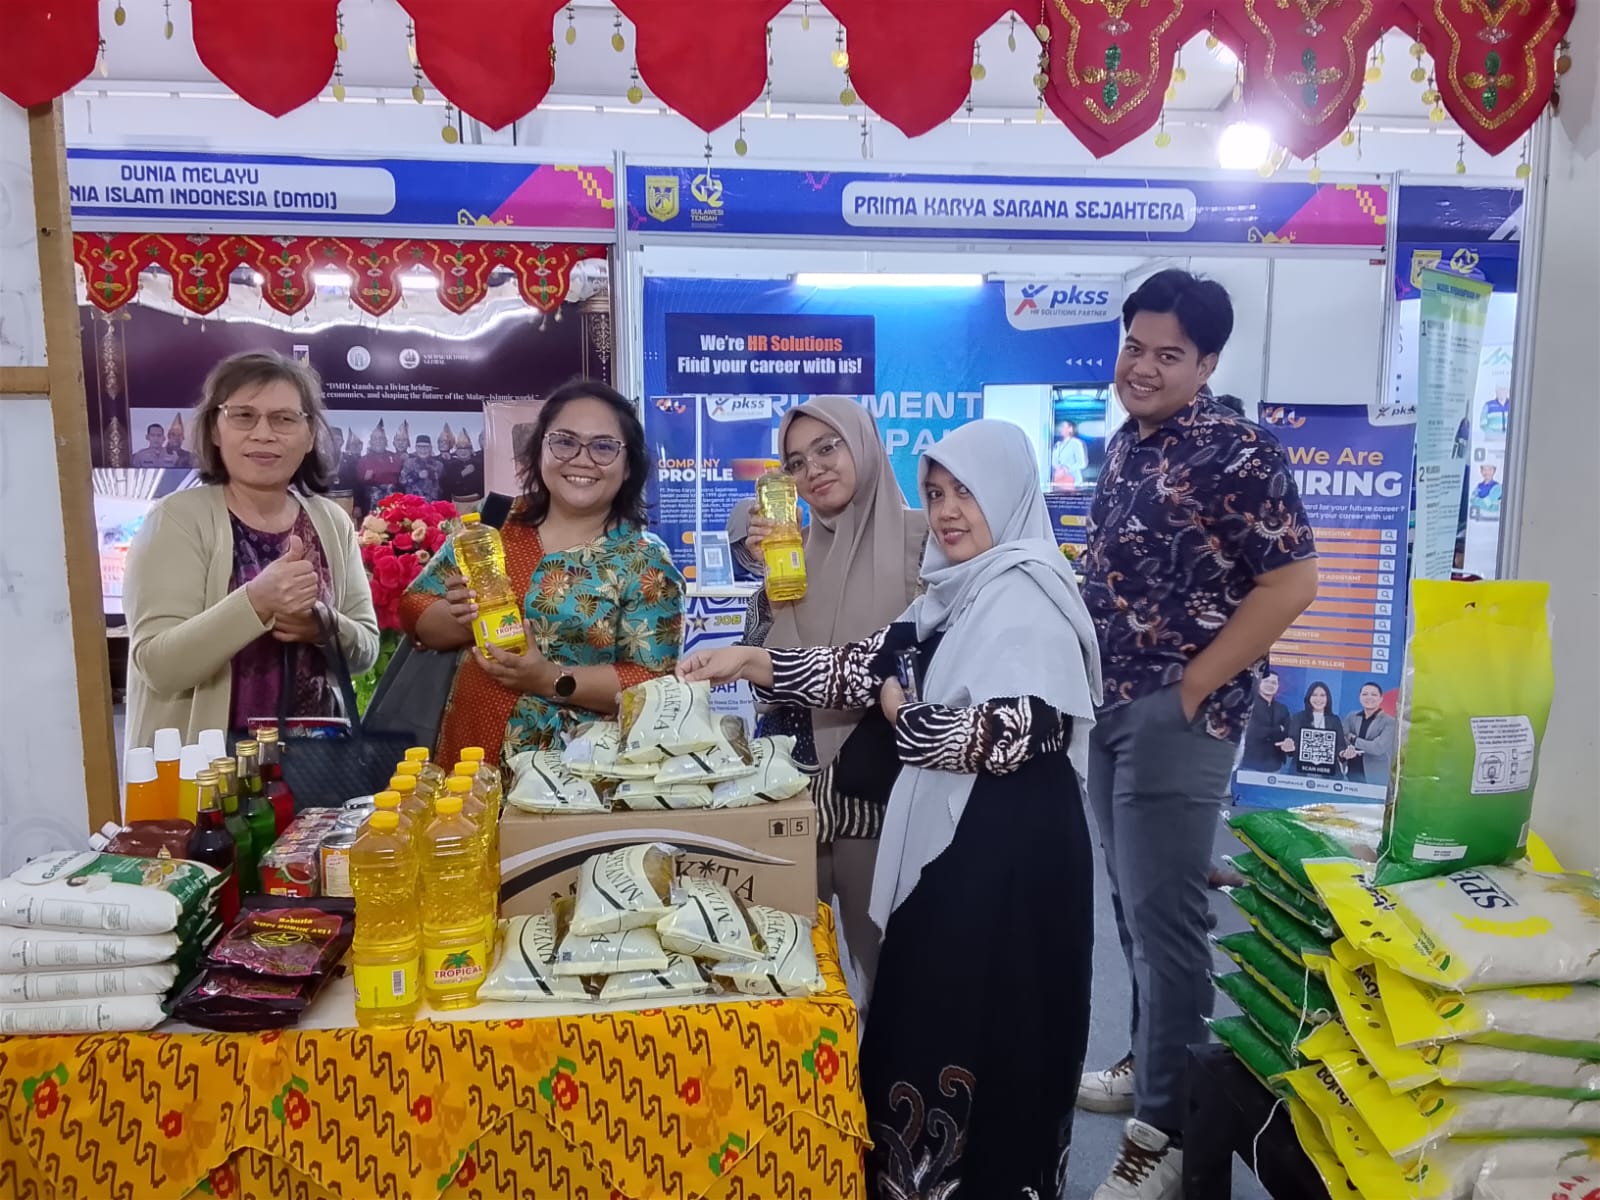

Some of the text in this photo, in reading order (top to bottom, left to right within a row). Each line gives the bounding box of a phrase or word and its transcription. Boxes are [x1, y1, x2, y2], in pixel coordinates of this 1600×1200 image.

[121, 165, 258, 184] DUNIA MELAYU
[69, 185, 99, 202] NIA
[106, 186, 164, 204] ISLAM
[171, 188, 268, 206] INDONESIA
[855, 196, 1184, 220] PRIMA KARYA SARANA SEJAHTERA
[1050, 285, 1109, 309] pkss
[700, 334, 842, 351] We're HR Solutions
[678, 356, 862, 375] Find your career with us!
[732, 397, 765, 412] pkss
[658, 459, 720, 468] COMPNY
[1288, 447, 1384, 465] We Are
[1290, 469, 1402, 497] IRING
[714, 615, 742, 626] JOB
[795, 821, 803, 833] 5
